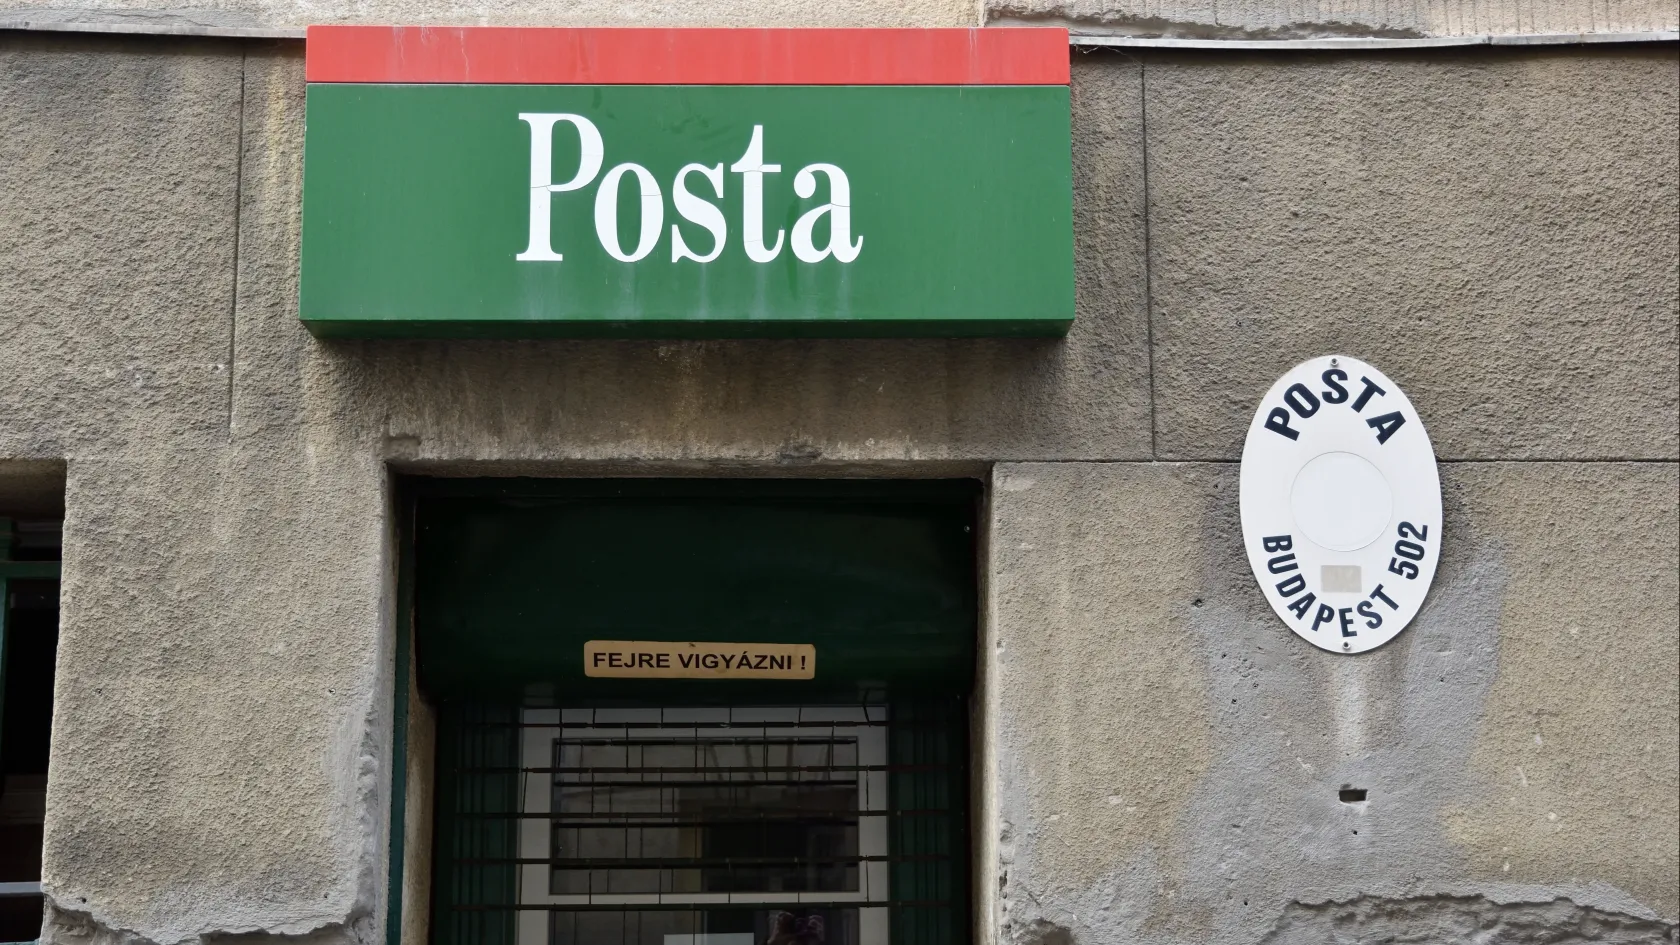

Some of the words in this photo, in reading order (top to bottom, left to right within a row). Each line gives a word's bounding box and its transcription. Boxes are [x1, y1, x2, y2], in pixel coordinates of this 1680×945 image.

[515, 112, 864, 264] Posta
[1263, 368, 1407, 446] POSTA
[1262, 534, 1400, 638] BUDAPEST
[1388, 521, 1428, 581] 502
[592, 651, 671, 669] FEJRE
